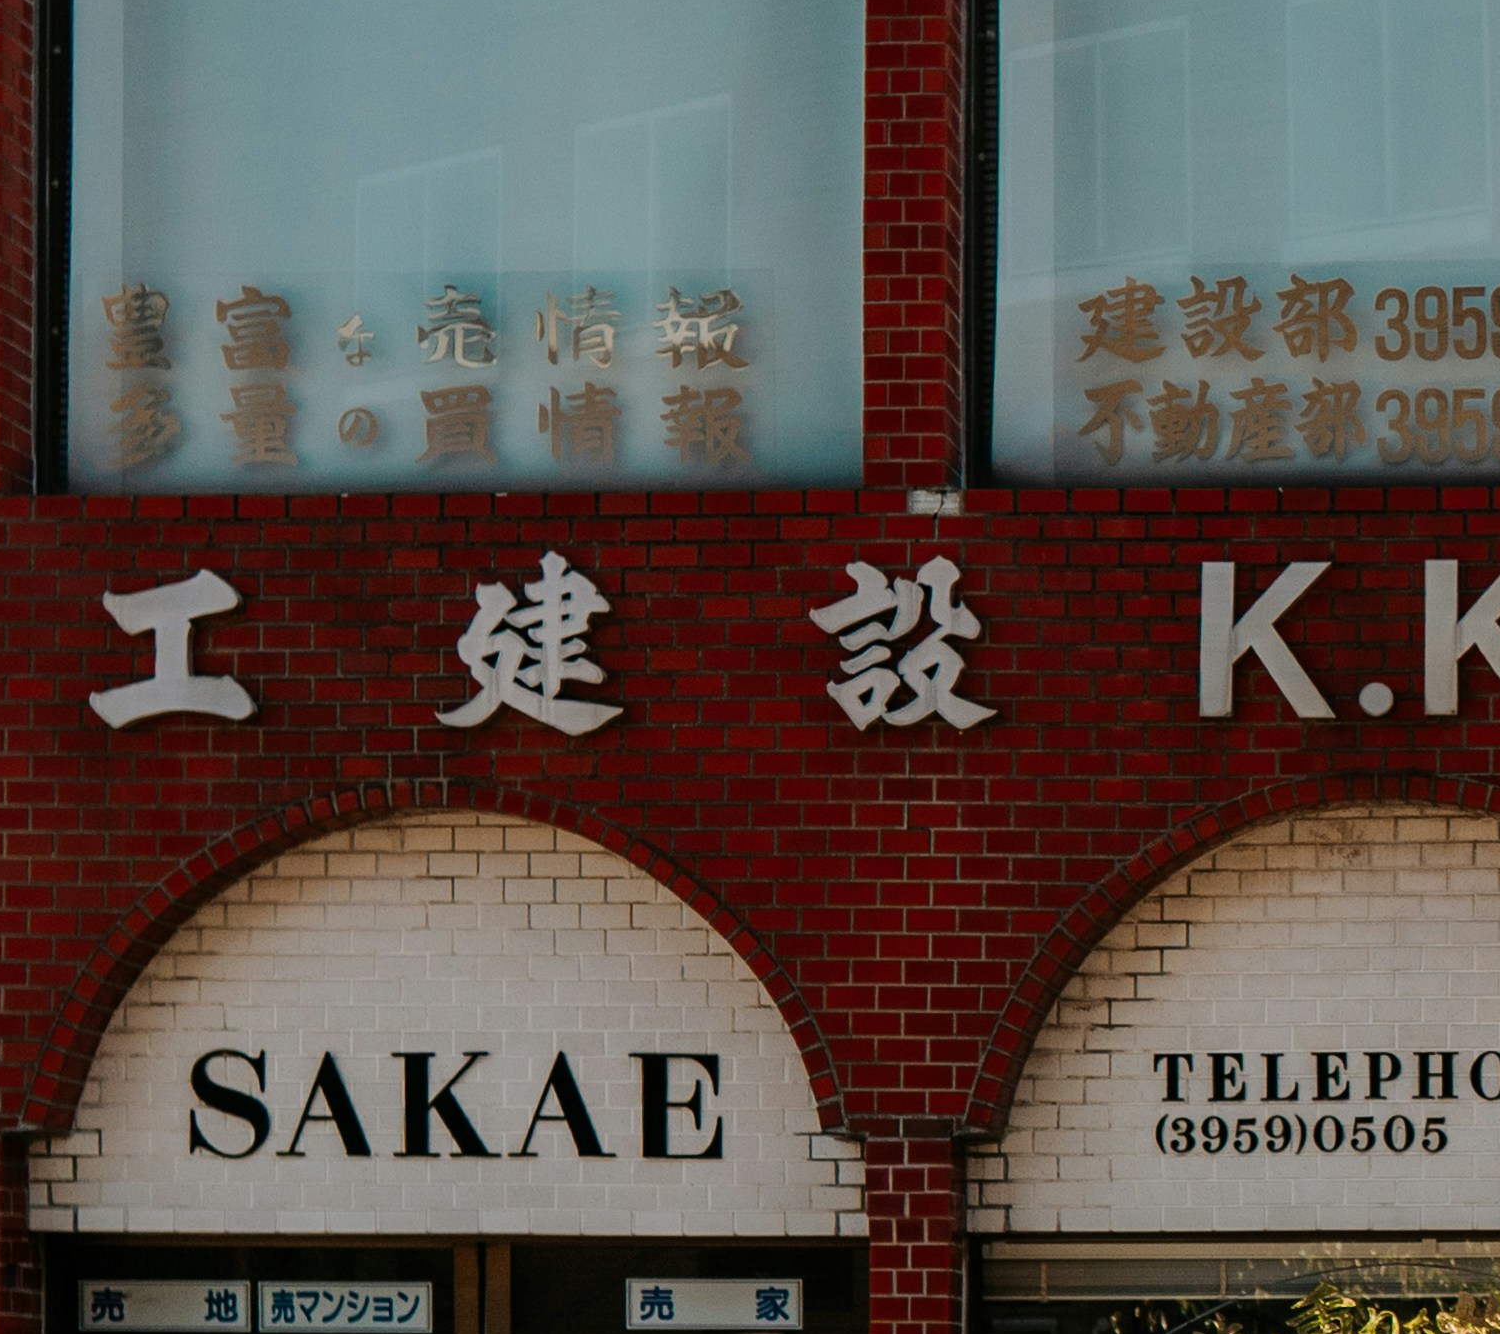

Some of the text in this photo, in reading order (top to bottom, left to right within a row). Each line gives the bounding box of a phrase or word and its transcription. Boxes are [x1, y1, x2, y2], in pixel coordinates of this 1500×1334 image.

[188, 1048, 725, 1161] SAKAE
[1154, 1111, 1450, 1156] (3959)0505
[270, 1289, 422, 1325] 売マンション
